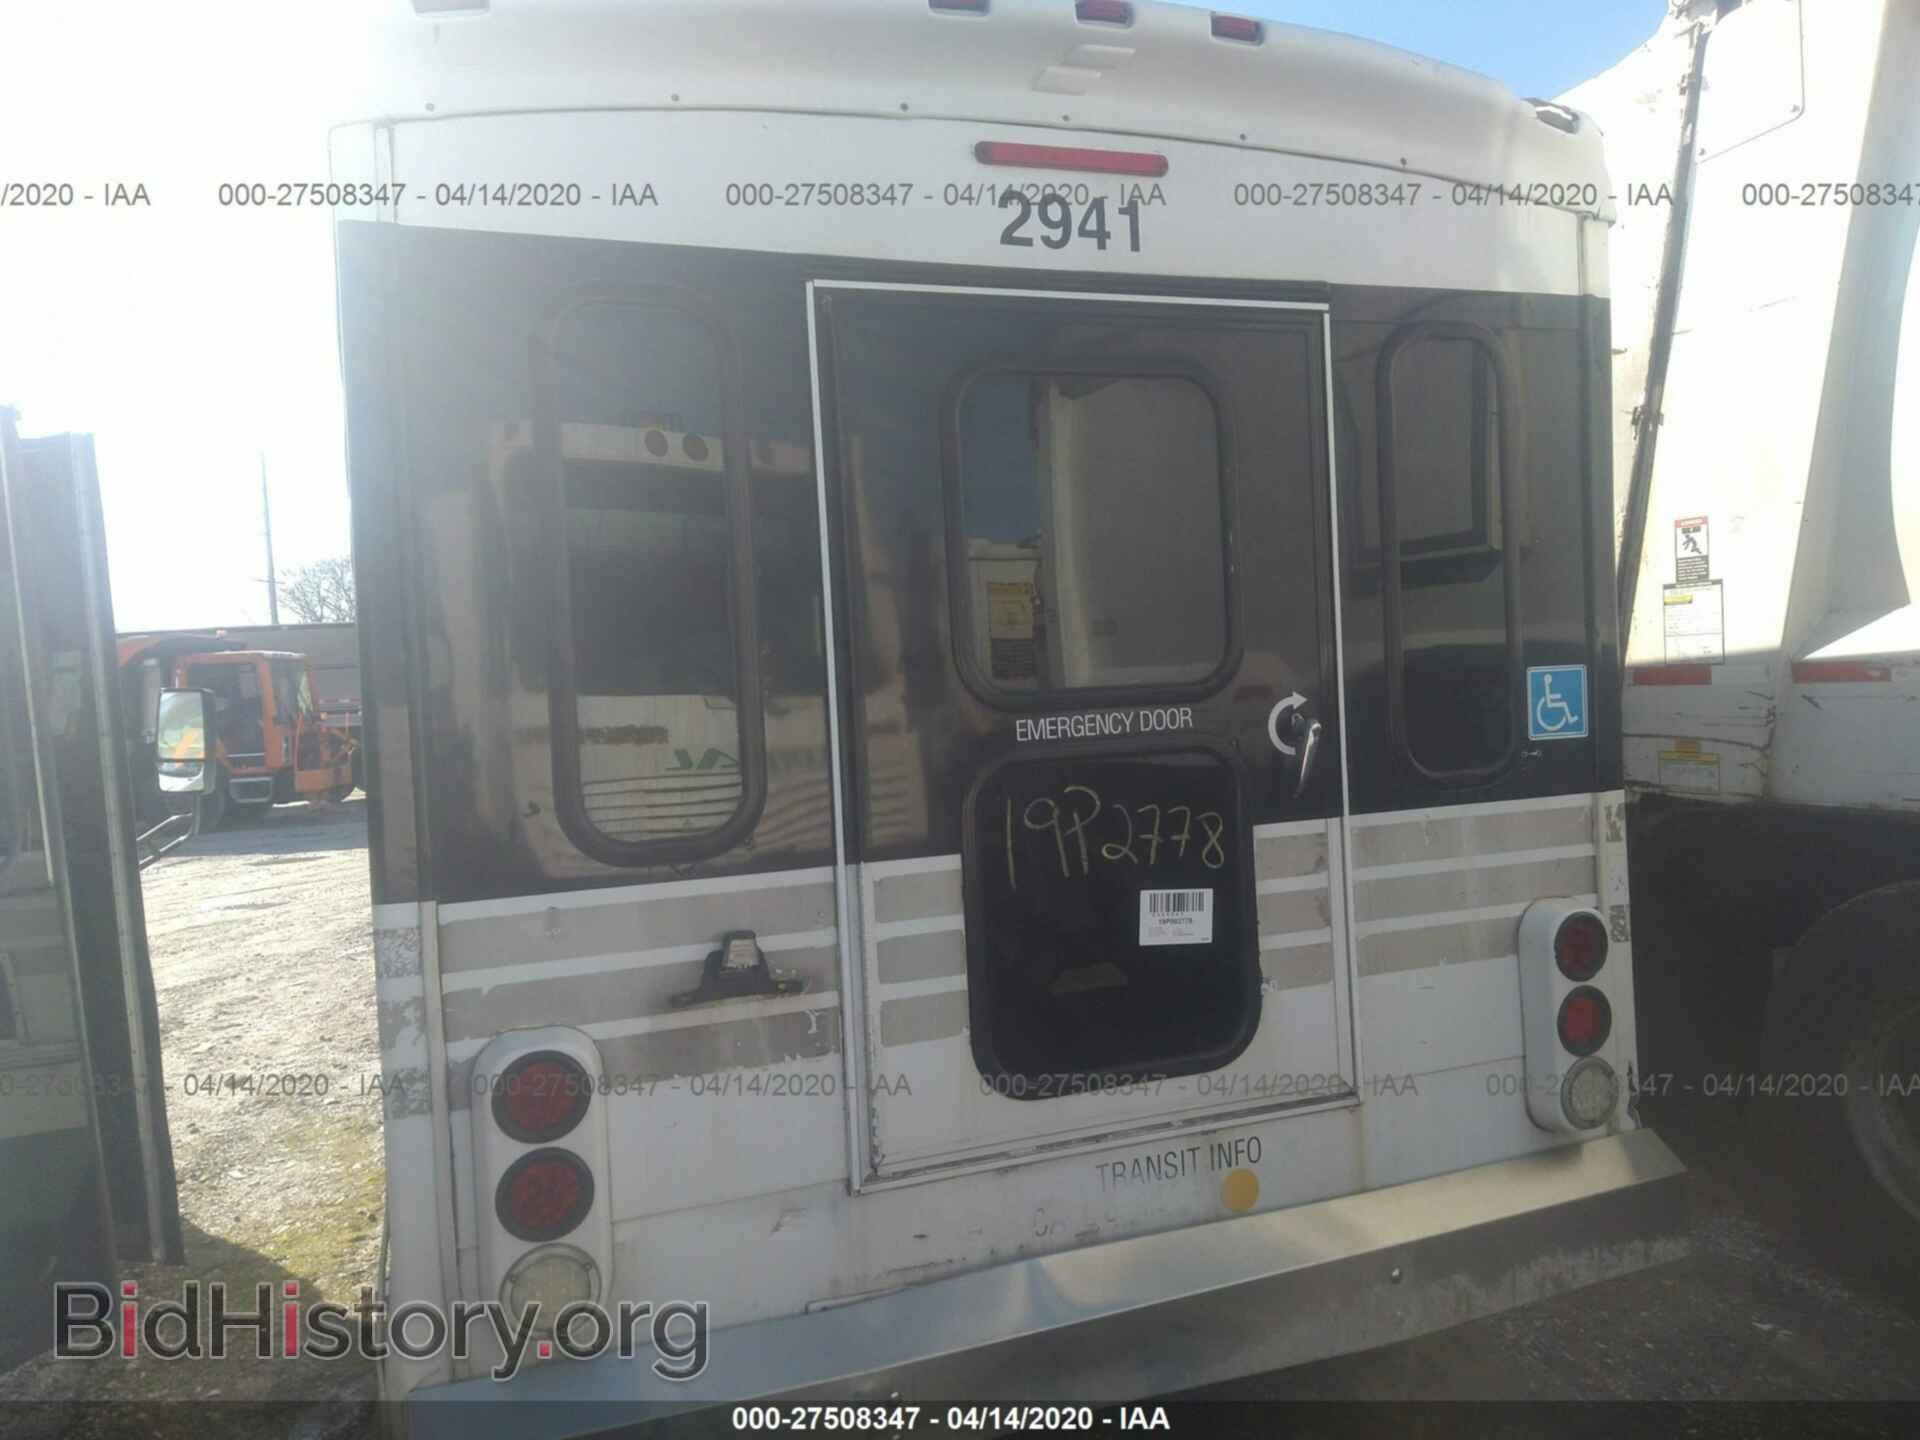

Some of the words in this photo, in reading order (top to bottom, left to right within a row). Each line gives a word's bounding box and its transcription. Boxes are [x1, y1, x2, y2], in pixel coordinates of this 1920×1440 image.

[998, 190, 1140, 252] 2941
[1016, 711, 1134, 741] EMERGENCY
[1140, 707, 1193, 731] DOOR
[1096, 1147, 1200, 1192] TRANSIT
[1209, 1136, 1262, 1171] INFO
